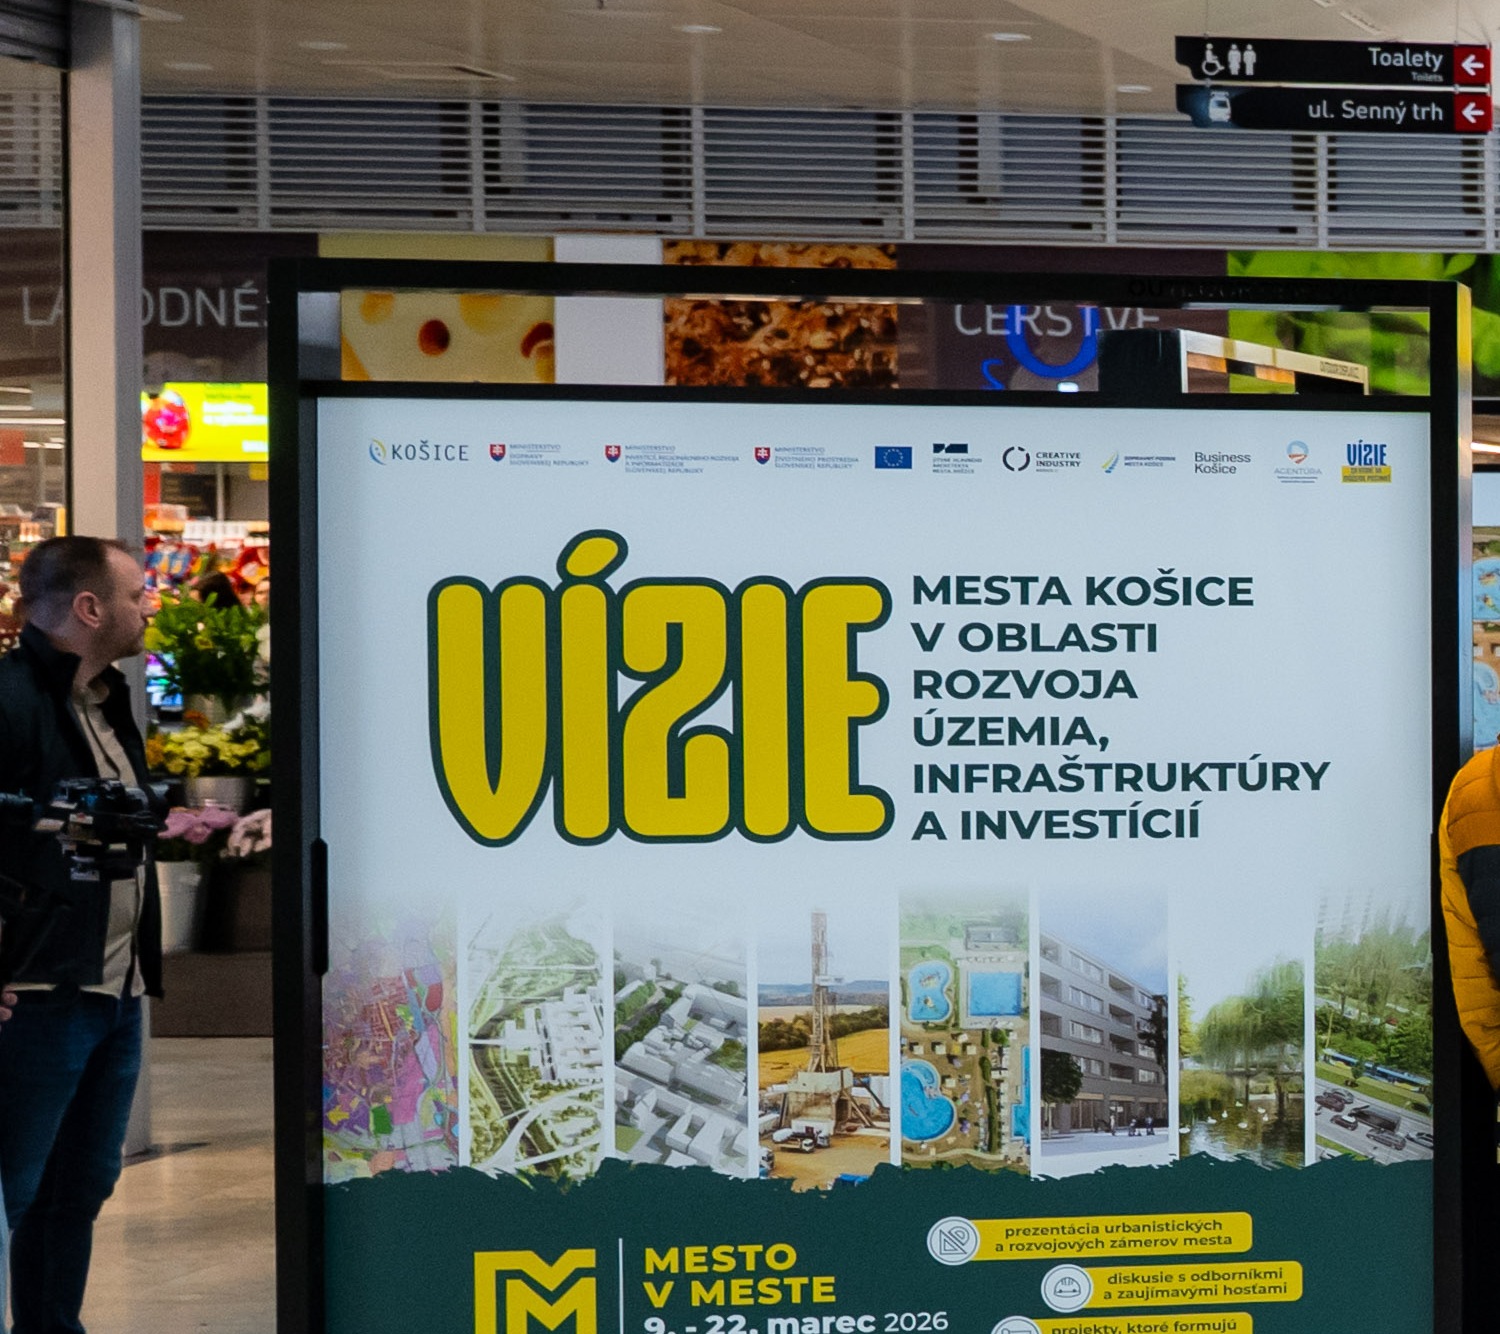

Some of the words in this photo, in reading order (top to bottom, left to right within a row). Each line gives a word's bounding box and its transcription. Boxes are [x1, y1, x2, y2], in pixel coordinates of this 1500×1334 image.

[1368, 47, 1443, 71] Toalety
[1412, 71, 1443, 82] Toilets
[1308, 100, 1335, 118] ul.
[1342, 100, 1405, 124] Senný
[1412, 102, 1443, 121] trh
[391, 440, 470, 461] KOŠICE
[1194, 452, 1251, 463] Business
[1346, 439, 1387, 466] VÍZIE
[1194, 463, 1237, 474] Košice
[912, 575, 1072, 606] MESTA
[1086, 568, 1254, 607] KOŠICE
[911, 622, 945, 653] V
[958, 622, 1158, 654] OBLASTI
[427, 529, 895, 847] VÍZIE
[913, 669, 1139, 700] ROZVOJA
[913, 708, 1109, 753] ÚZEMIA,
[914, 753, 1331, 794] INFRAŠTRUKTÚRY
[911, 810, 948, 841] A
[961, 800, 1203, 840] INVESTÍCIÍ
[1004, 1222, 1100, 1239] prezentácia
[1104, 1218, 1223, 1236] urbanistických
[995, 1243, 1004, 1253] a
[1008, 1237, 1105, 1254] rozvojových
[1109, 1234, 1179, 1250] zámerov
[1183, 1235, 1233, 1247] mesta
[644, 1243, 798, 1274] MESTO
[1107, 1271, 1173, 1286] diskusie
[1178, 1274, 1187, 1283] s
[1190, 1267, 1284, 1283] odborníkmi
[643, 1280, 675, 1308] V
[690, 1276, 837, 1307] MESTE
[1103, 1290, 1112, 1300] a
[1117, 1282, 1219, 1301] zaujímavými
[1223, 1281, 1288, 1297] hosťami
[883, 1311, 949, 1333] 2026
[1126, 1320, 1169, 1334] ktoré
